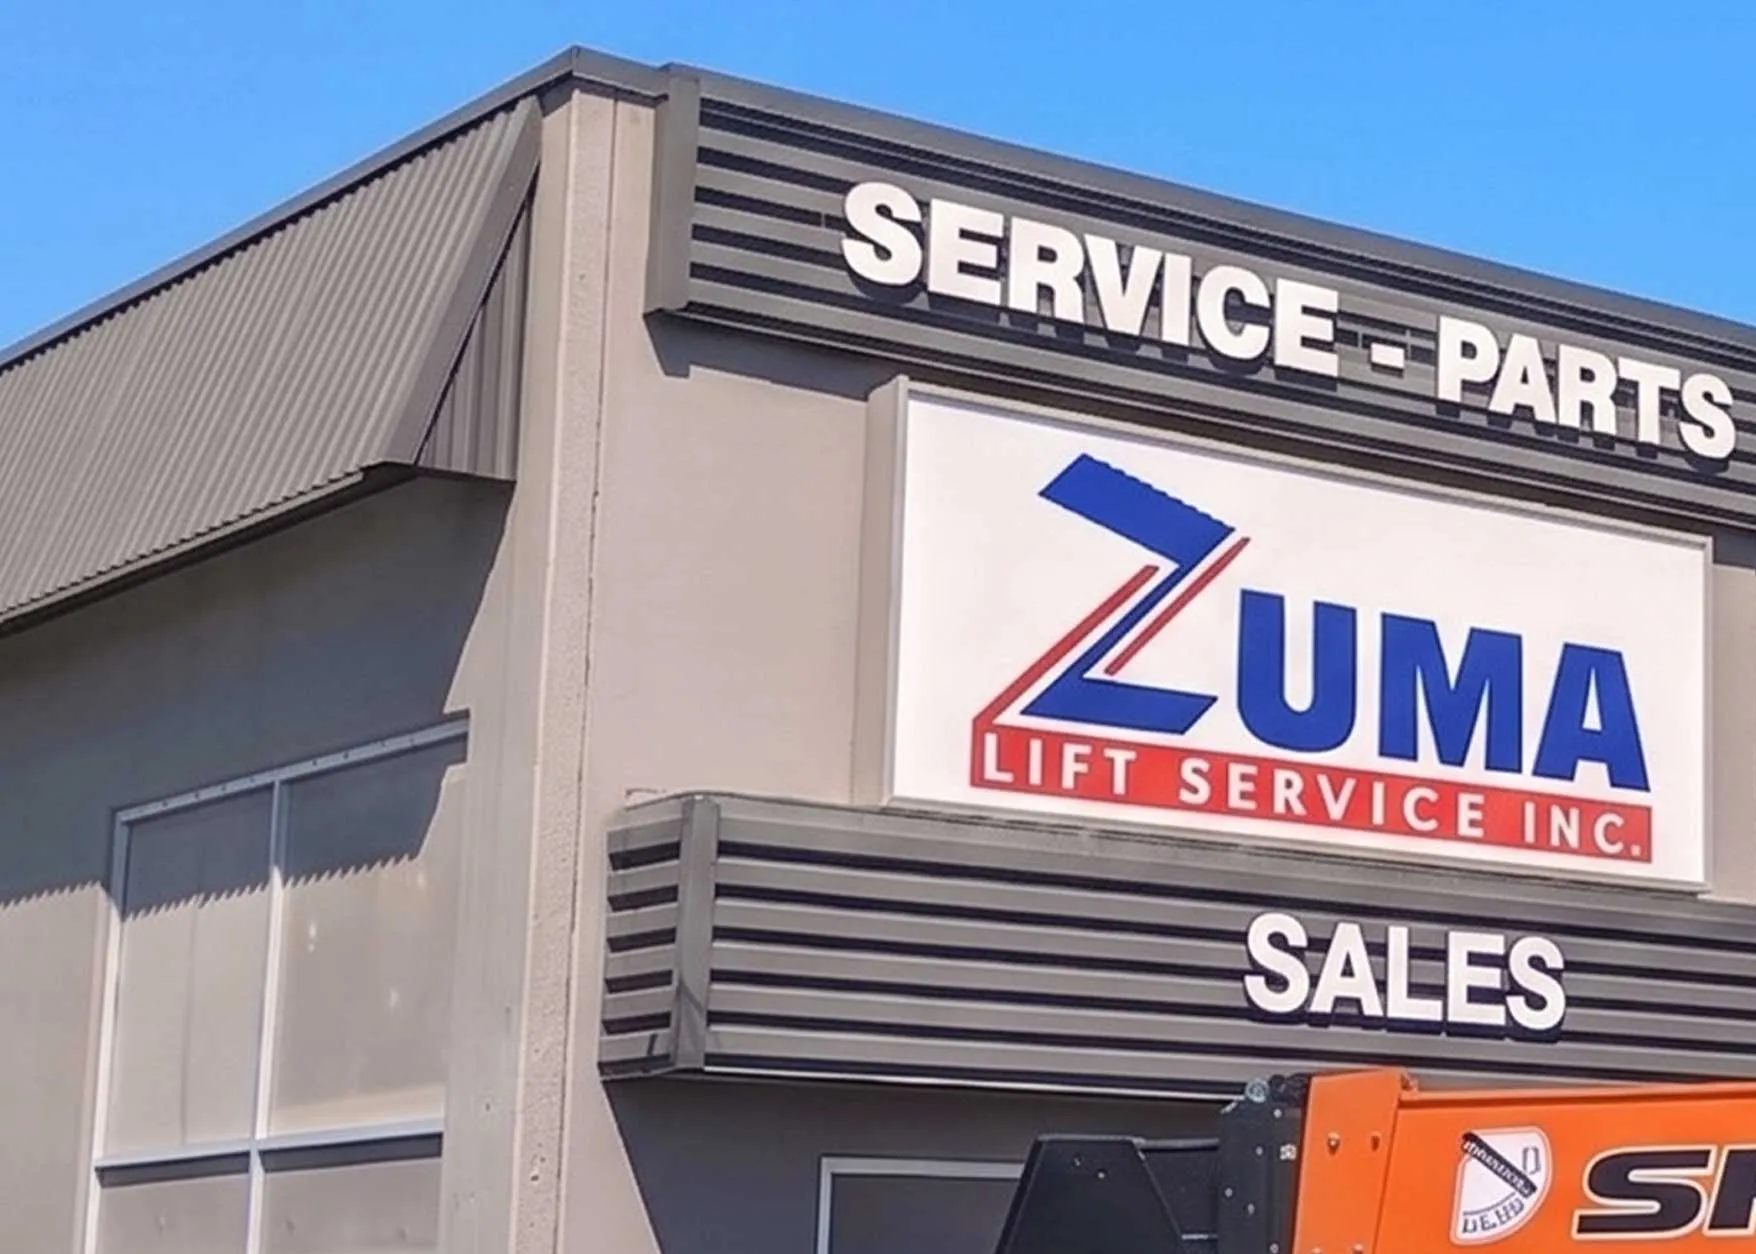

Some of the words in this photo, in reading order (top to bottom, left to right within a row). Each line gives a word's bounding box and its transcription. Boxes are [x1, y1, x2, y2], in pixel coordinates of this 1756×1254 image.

[841, 181, 1339, 378] SERVICE
[1436, 315, 1736, 462] PARTS
[1020, 452, 1651, 792] ZUMA
[982, 731, 1137, 797] LIFT
[1179, 756, 1485, 837] SERVICE
[1523, 802, 1643, 858] INC.
[1244, 911, 1566, 1031] SALES
